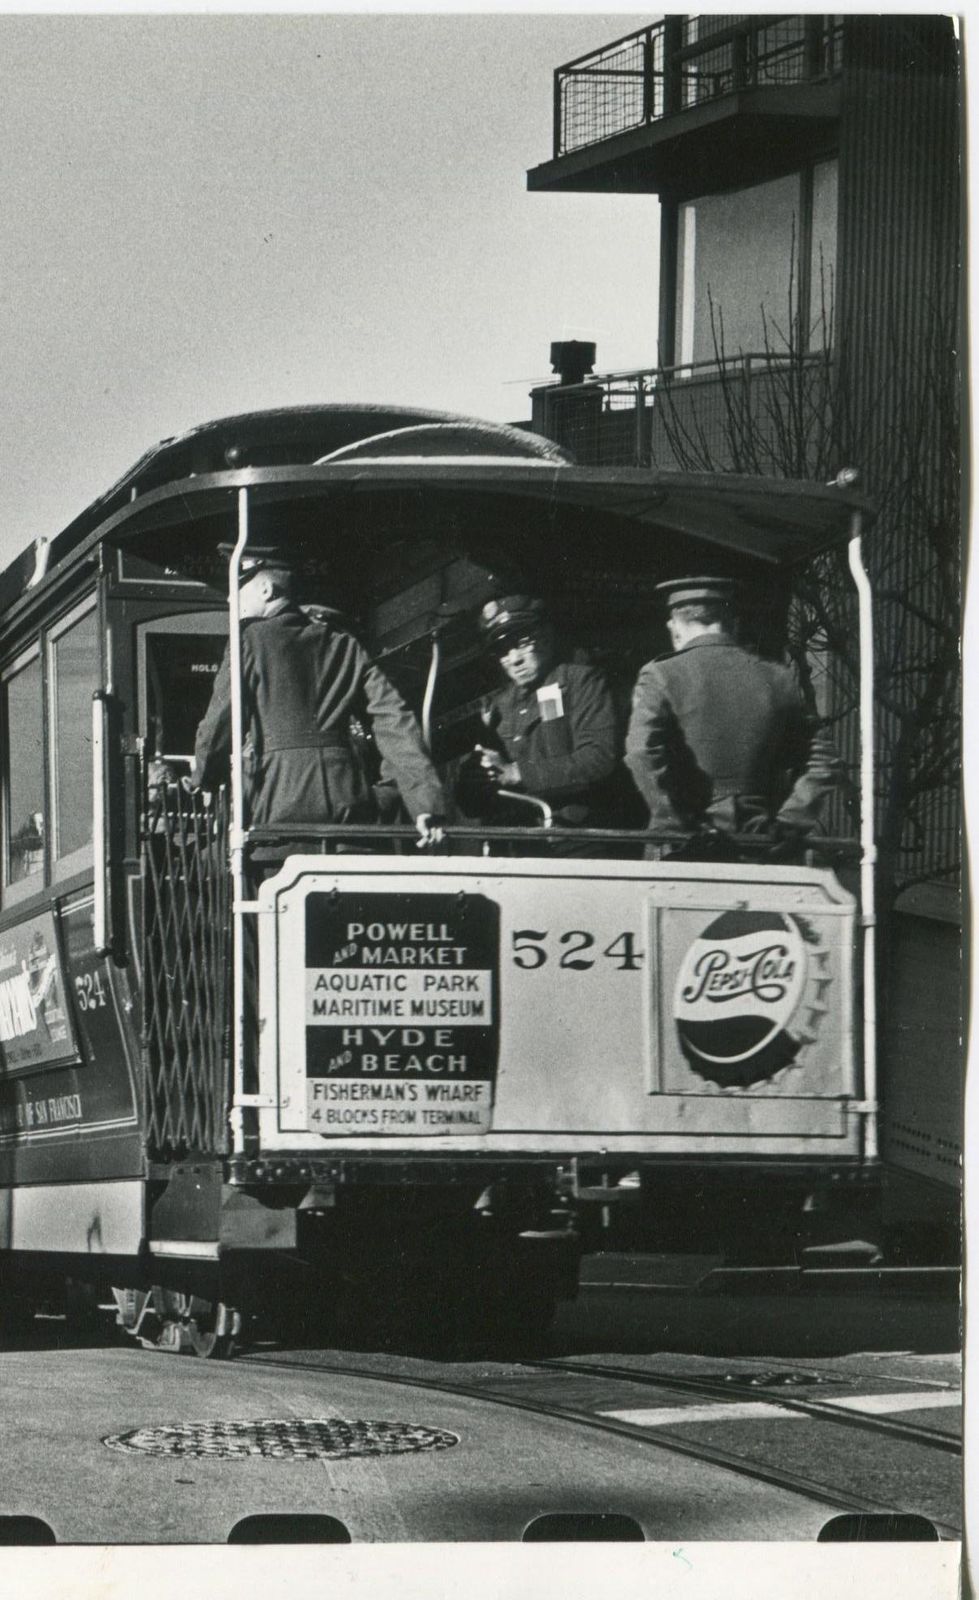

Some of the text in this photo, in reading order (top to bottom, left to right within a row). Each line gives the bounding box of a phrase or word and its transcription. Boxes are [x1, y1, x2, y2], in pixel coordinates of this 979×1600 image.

[347, 922, 454, 942] POWELL
[332, 942, 467, 966] AND MARKET
[511, 929, 645, 971] 524
[75, 969, 107, 1011] 524
[314, 974, 480, 994] AQUATIC PARK
[312, 999, 485, 1018] MARITIME MUSEUM
[341, 1028, 455, 1047] HYDE
[327, 1050, 467, 1073] AND BEACH
[313, 1082, 484, 1102] FISHERMAN'S WHARF
[311, 1107, 482, 1125] 4 BLOCKS FROM TERMINAL
